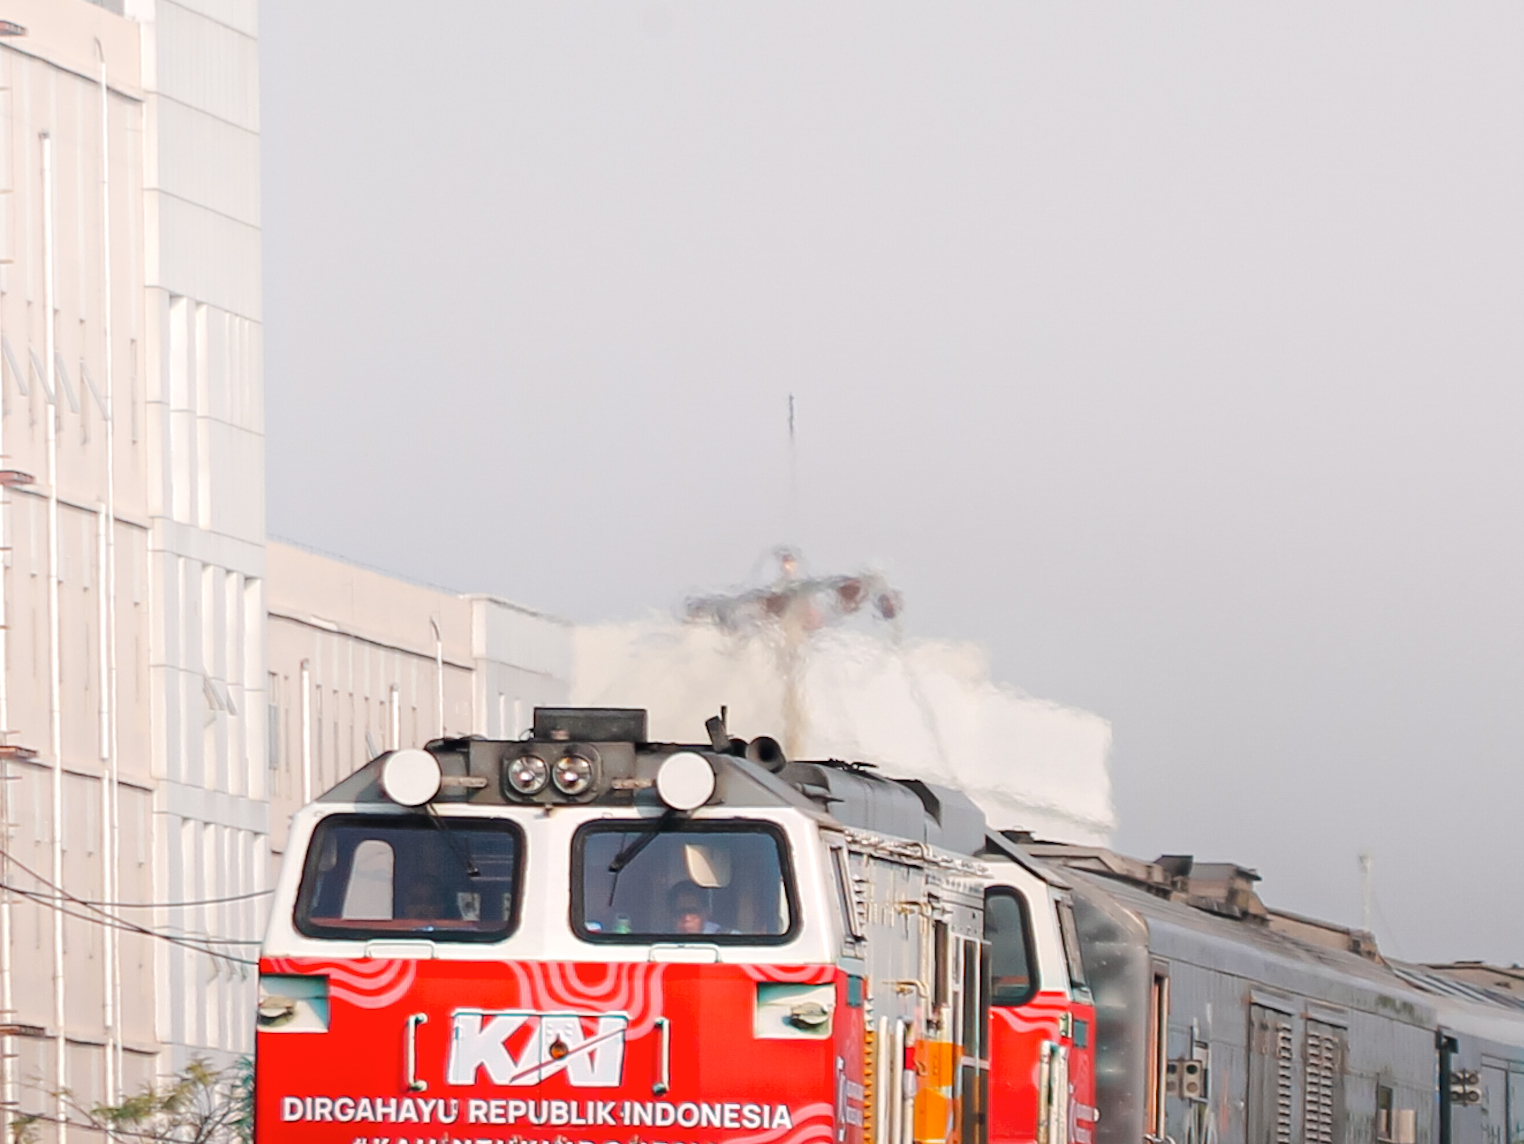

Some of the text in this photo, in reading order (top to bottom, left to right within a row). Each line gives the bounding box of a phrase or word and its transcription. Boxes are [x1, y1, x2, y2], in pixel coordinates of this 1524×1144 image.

[446, 1011, 627, 1088] KAI
[282, 1096, 794, 1130] DIRGAHAYU REPUBLIK INDONESIA
